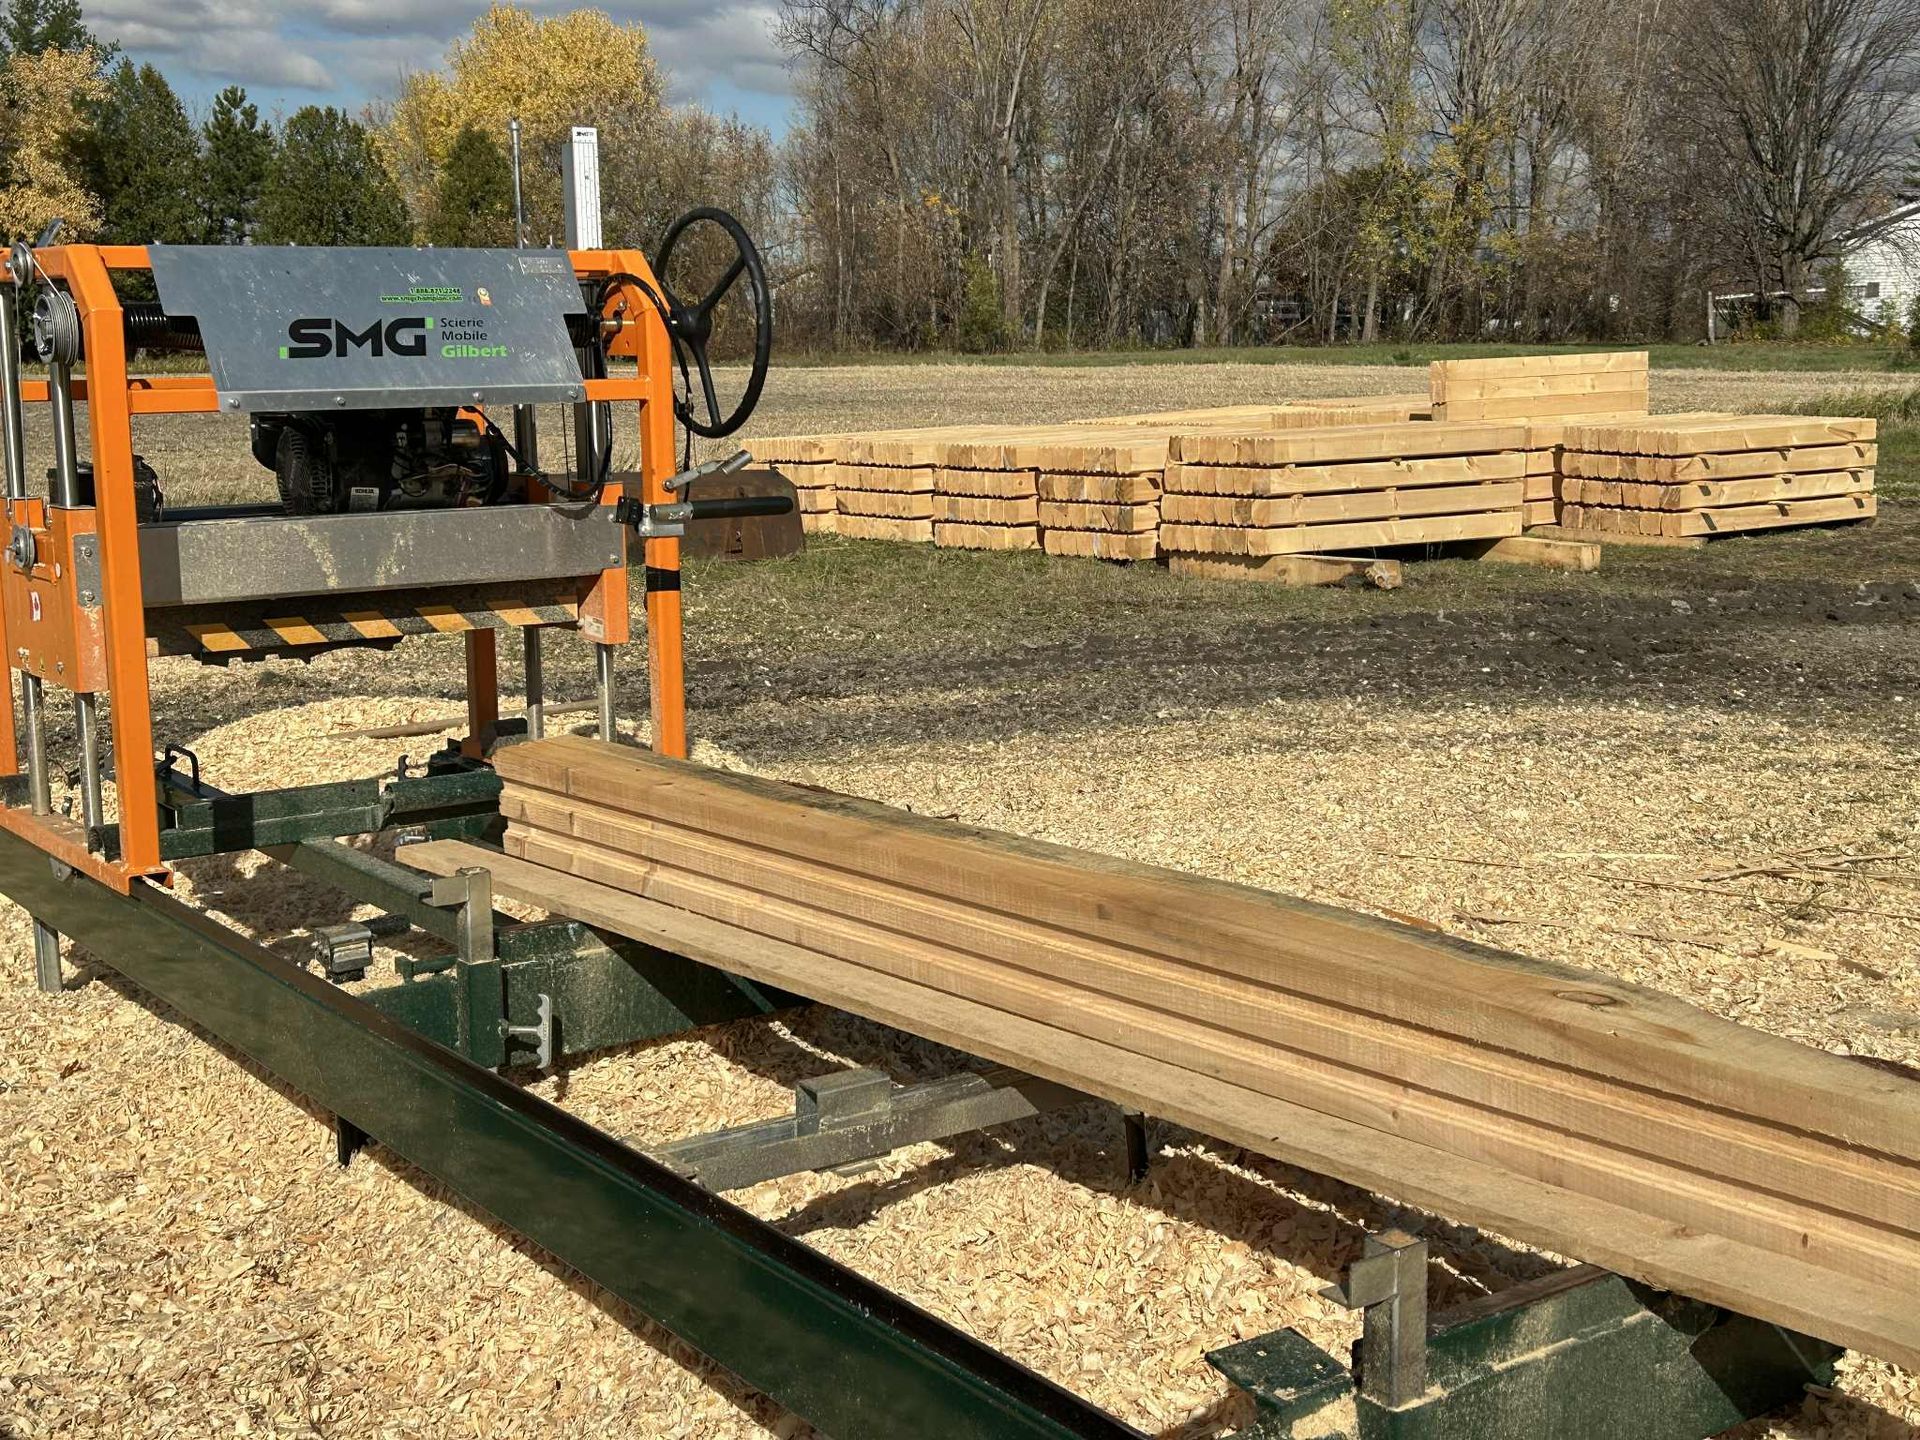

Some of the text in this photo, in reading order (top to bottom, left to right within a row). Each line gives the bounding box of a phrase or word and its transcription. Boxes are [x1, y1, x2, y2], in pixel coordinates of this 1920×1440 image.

[440, 318, 484, 328] Scierie
[288, 317, 427, 359] SMG
[441, 331, 488, 341] Mobile
[441, 345, 508, 358] Gilbert
